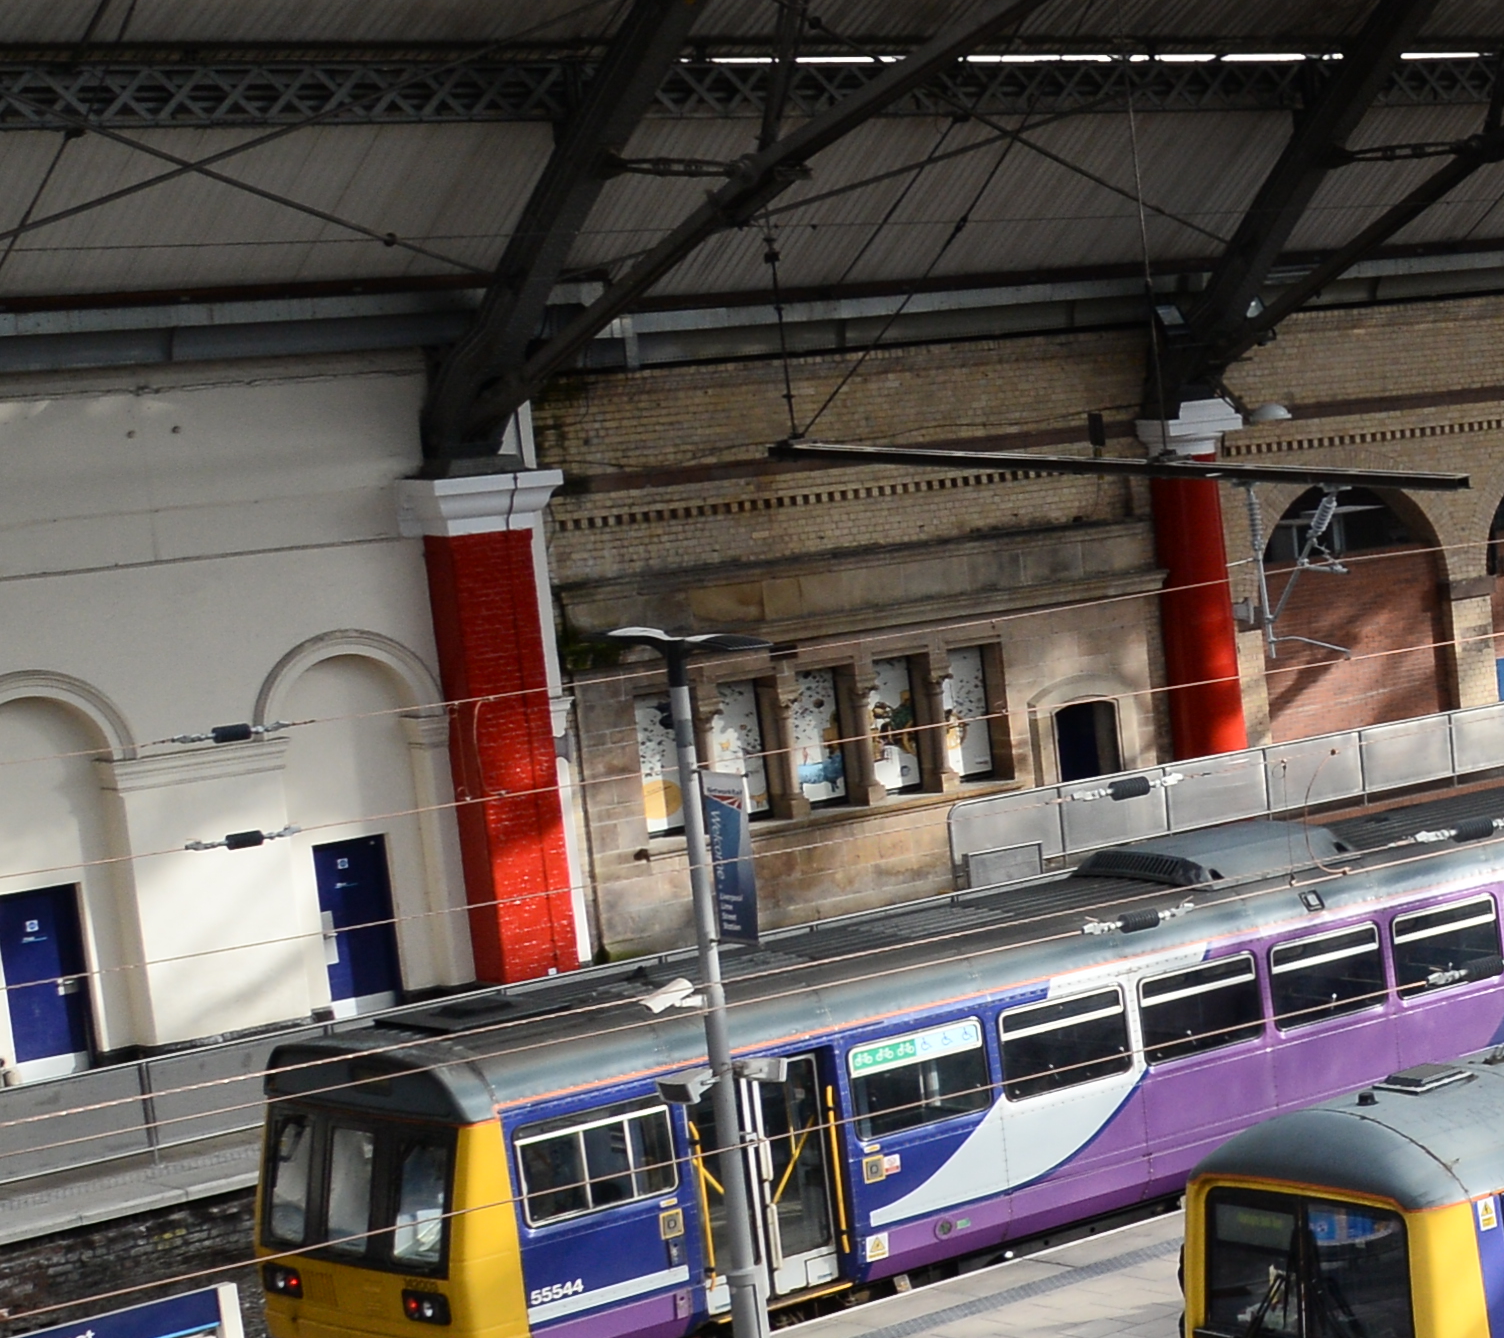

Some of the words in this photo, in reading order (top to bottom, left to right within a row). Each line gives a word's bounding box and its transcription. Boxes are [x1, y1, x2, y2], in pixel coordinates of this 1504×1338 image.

[710, 810, 726, 881] Welcome
[719, 891, 743, 903] Liverpool
[721, 901, 733, 911] Lime
[722, 912, 737, 921] Street
[723, 921, 741, 931] Station
[530, 1277, 584, 1305] 55544
